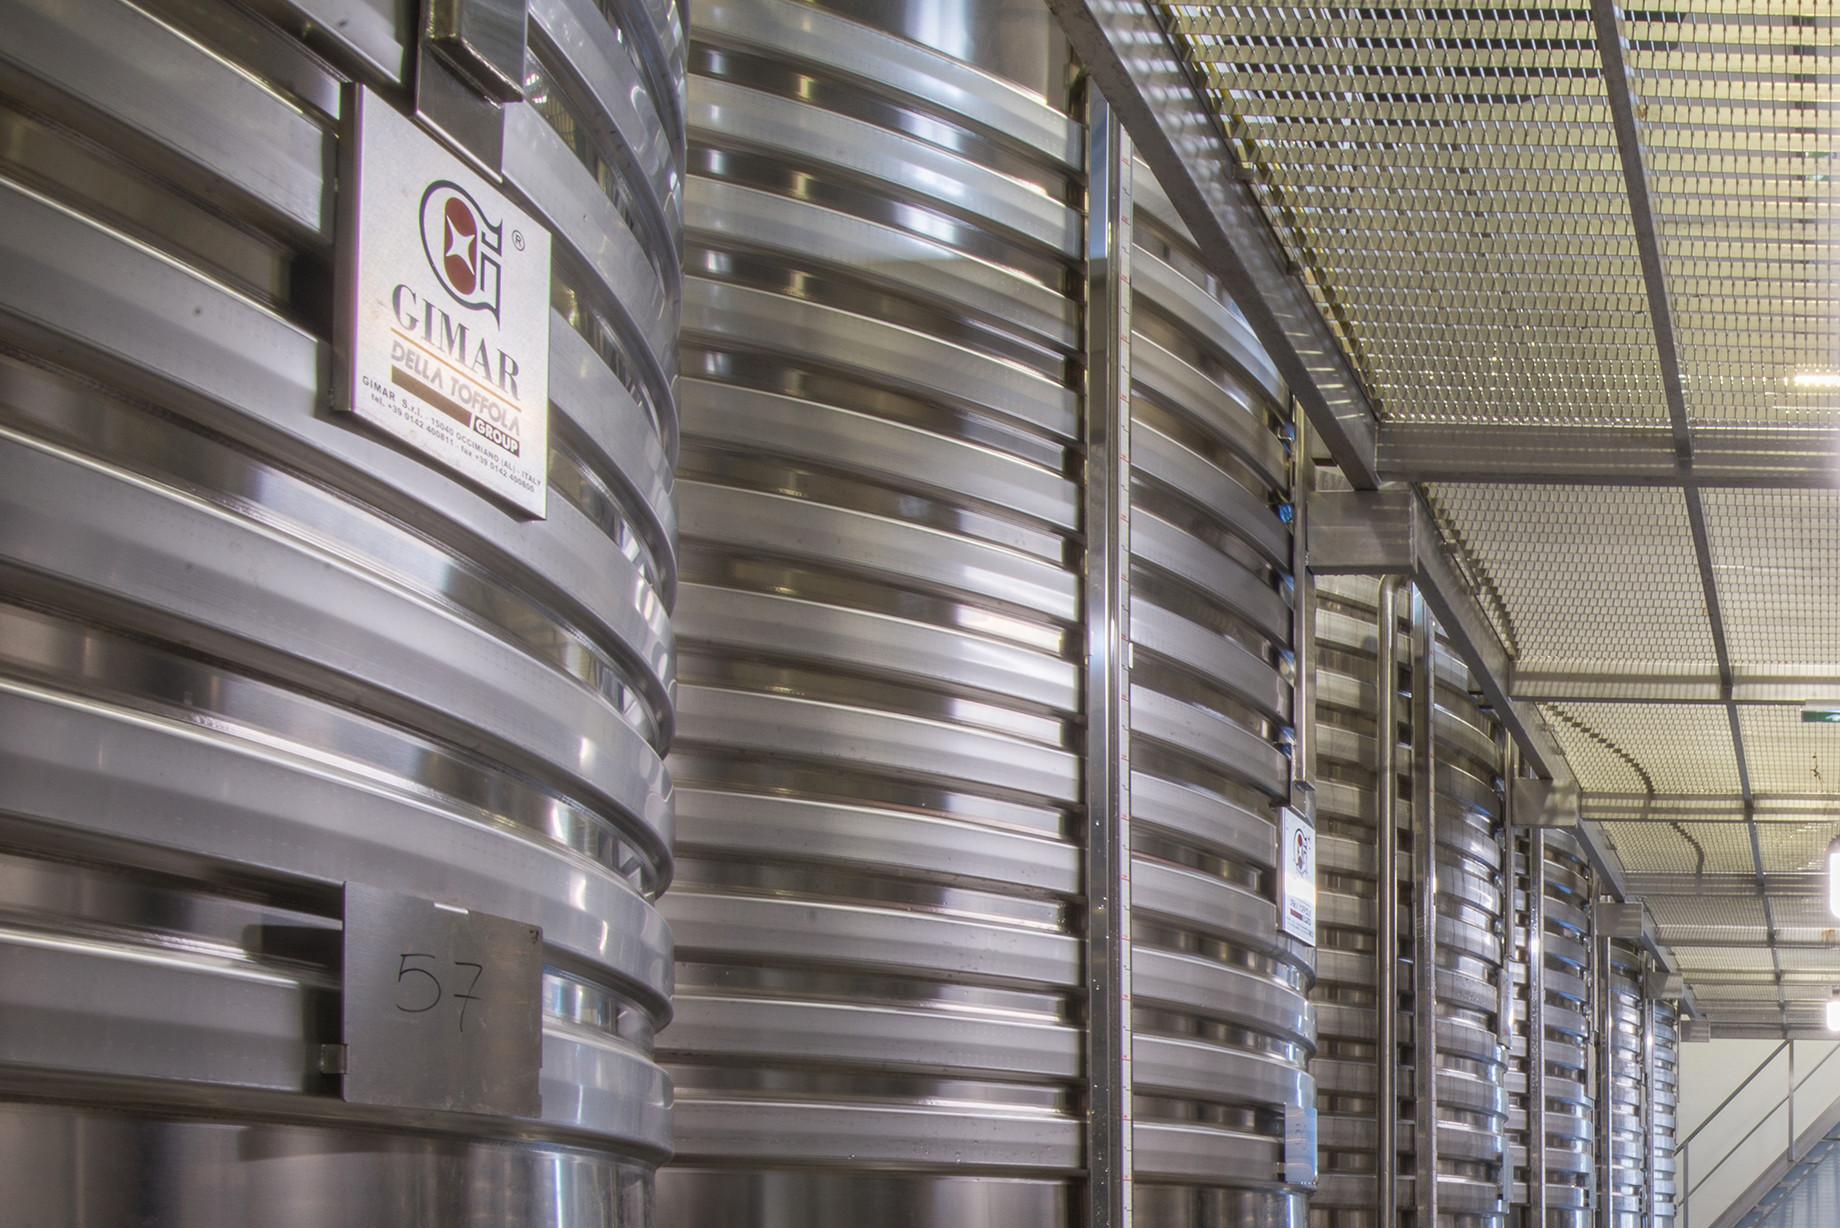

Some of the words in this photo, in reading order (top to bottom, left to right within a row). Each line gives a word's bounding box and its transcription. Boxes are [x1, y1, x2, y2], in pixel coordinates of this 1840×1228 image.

[391, 284, 521, 401] GIMAR
[362, 376, 395, 401] GIMAR
[431, 418, 454, 436] 15040
[456, 432, 499, 462] OCCIMIANO
[521, 471, 541, 486] ITALY
[391, 340, 443, 389] DELLA
[451, 377, 520, 436] TOFFOLA
[388, 404, 402, 416] +39
[405, 412, 424, 429] 0142
[426, 425, 453, 446] 400811
[461, 445, 473, 457] fax
[490, 462, 507, 477] 0142
[475, 418, 519, 453] GROUP
[396, 954, 483, 1032] 57
